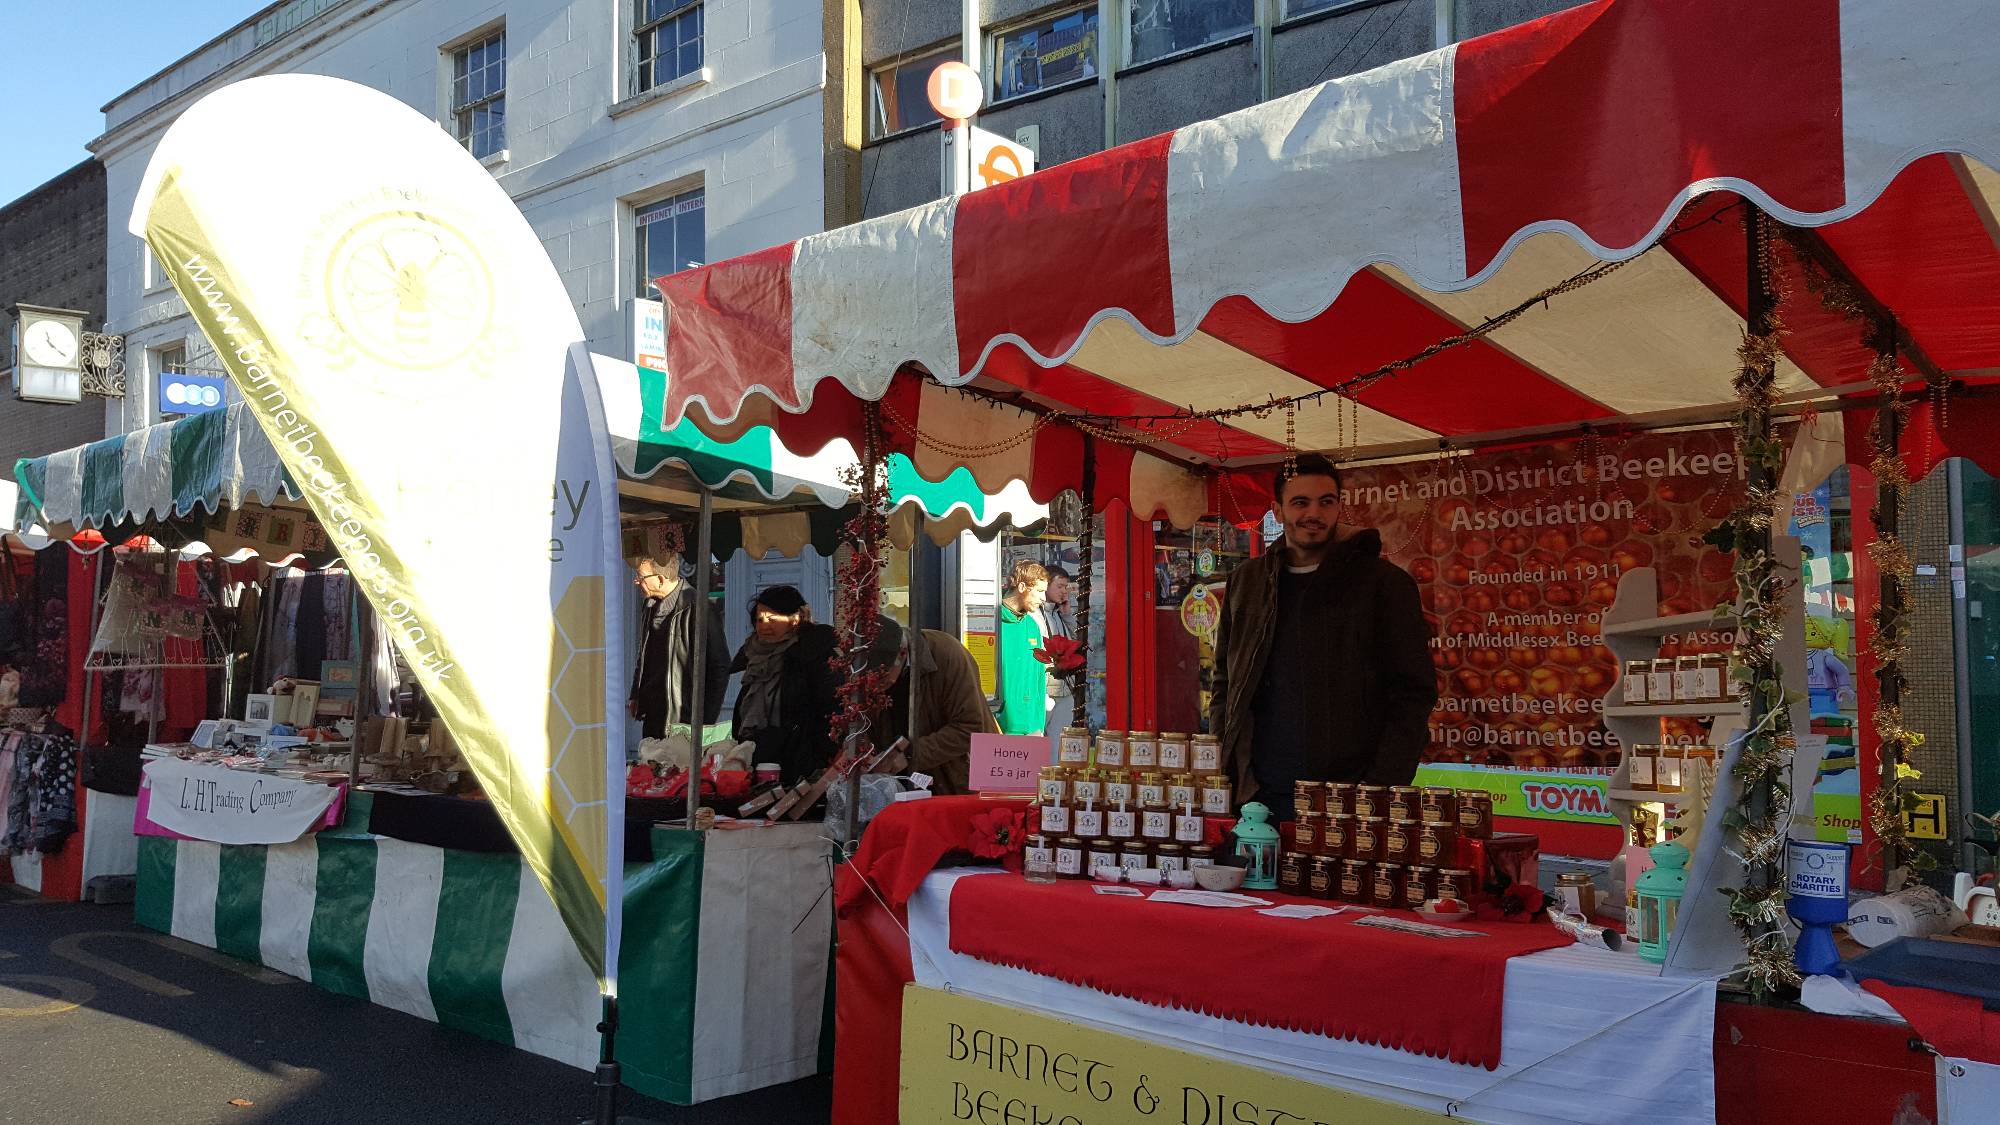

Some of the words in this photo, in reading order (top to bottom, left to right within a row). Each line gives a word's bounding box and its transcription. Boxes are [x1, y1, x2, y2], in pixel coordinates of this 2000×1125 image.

[640, 208, 672, 225] INTERNET
[183, 254, 454, 682] www.barnetbeekeepers.org.uk
[1417, 473, 1466, 499] and
[1472, 461, 1588, 496] District
[1450, 496, 1634, 532] Association
[1468, 570, 1543, 586] Founded
[1551, 566, 1567, 581] in
[1575, 563, 1620, 581] 1911
[1488, 612, 1500, 627] A
[1504, 609, 1581, 627] member
[1446, 632, 1464, 648] of
[1468, 631, 1559, 648] Middlesex
[994, 747, 1029, 760] Honey
[990, 766, 1004, 777] £5
[1007, 769, 1013, 777] a
[1016, 768, 1031, 779] jar
[249, 779, 297, 814] Company
[1791, 881, 1841, 893] CHARITIES
[1797, 874, 1836, 885] ROTARY
[947, 1022, 1114, 1102] BARNET
[1133, 1074, 1161, 1115] &
